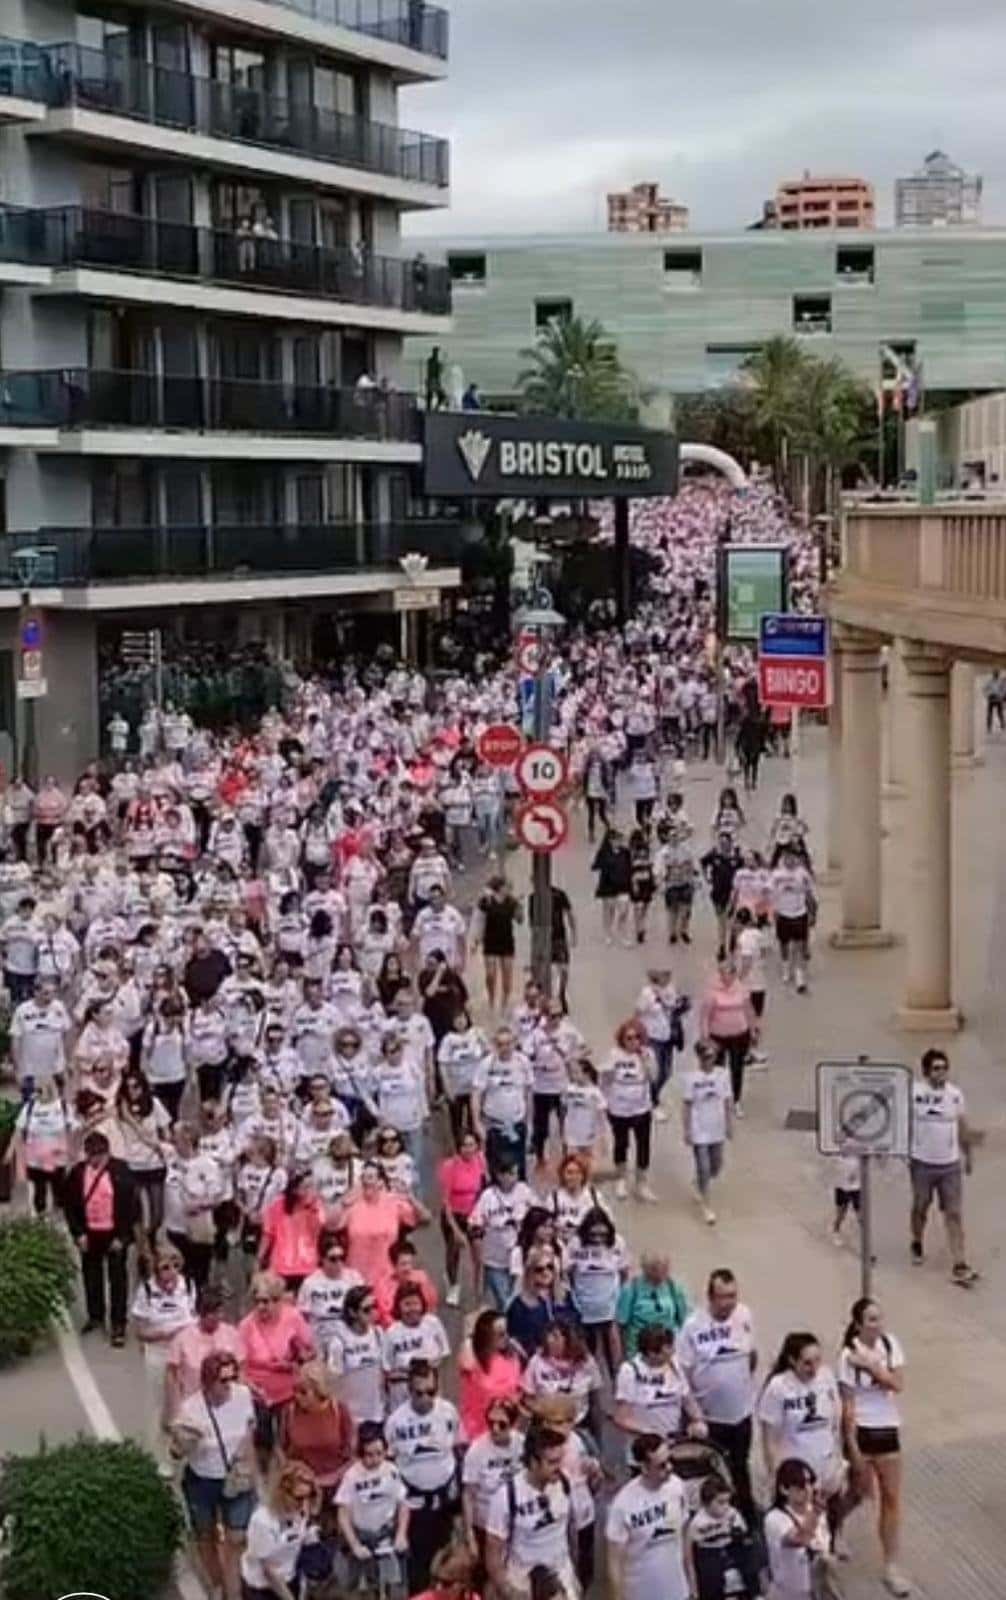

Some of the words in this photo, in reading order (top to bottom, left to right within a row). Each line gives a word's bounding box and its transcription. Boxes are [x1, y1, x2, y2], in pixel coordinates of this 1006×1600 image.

[500, 441, 608, 476] BRISTOL
[766, 667, 820, 695] BINGO
[532, 762, 556, 780] 10
